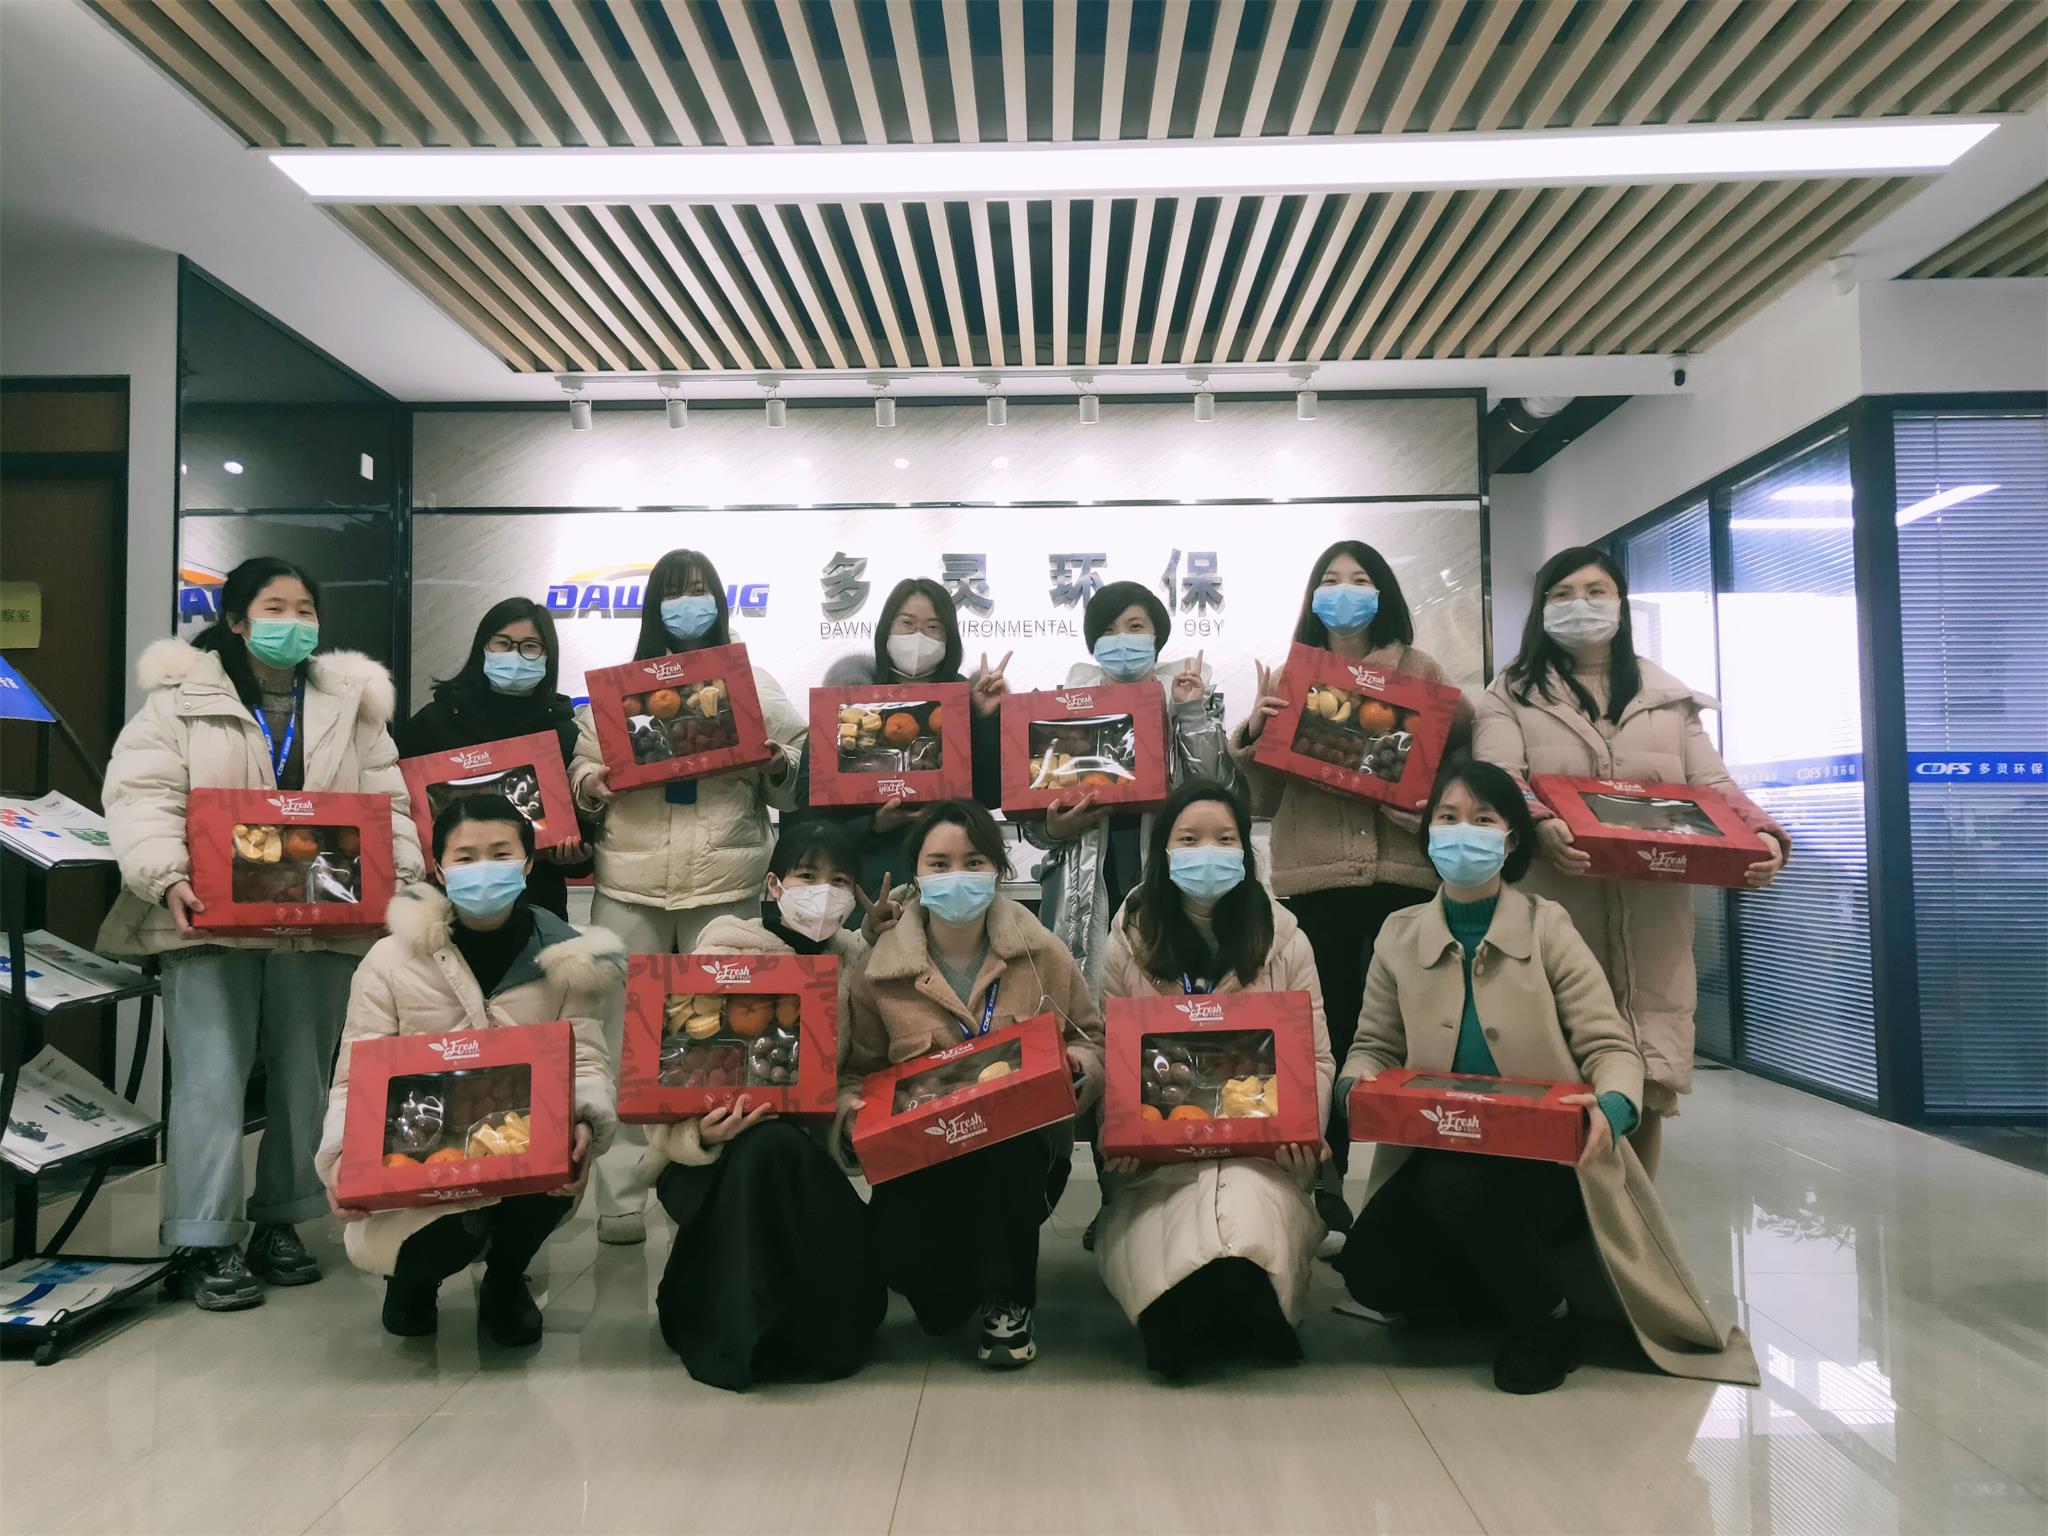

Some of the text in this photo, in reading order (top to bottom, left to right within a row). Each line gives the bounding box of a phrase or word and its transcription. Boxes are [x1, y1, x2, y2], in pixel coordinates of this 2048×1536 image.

[1916, 762, 2044, 775] CDFS 多灵环保
[1649, 851, 1687, 868] Fresh
[715, 962, 749, 981] Fresh
[1189, 1000, 1221, 1019] Fresh
[442, 1037, 478, 1058] Fresh
[946, 1112, 982, 1143] Fresh
[1437, 1109, 1479, 1132] Fresh
